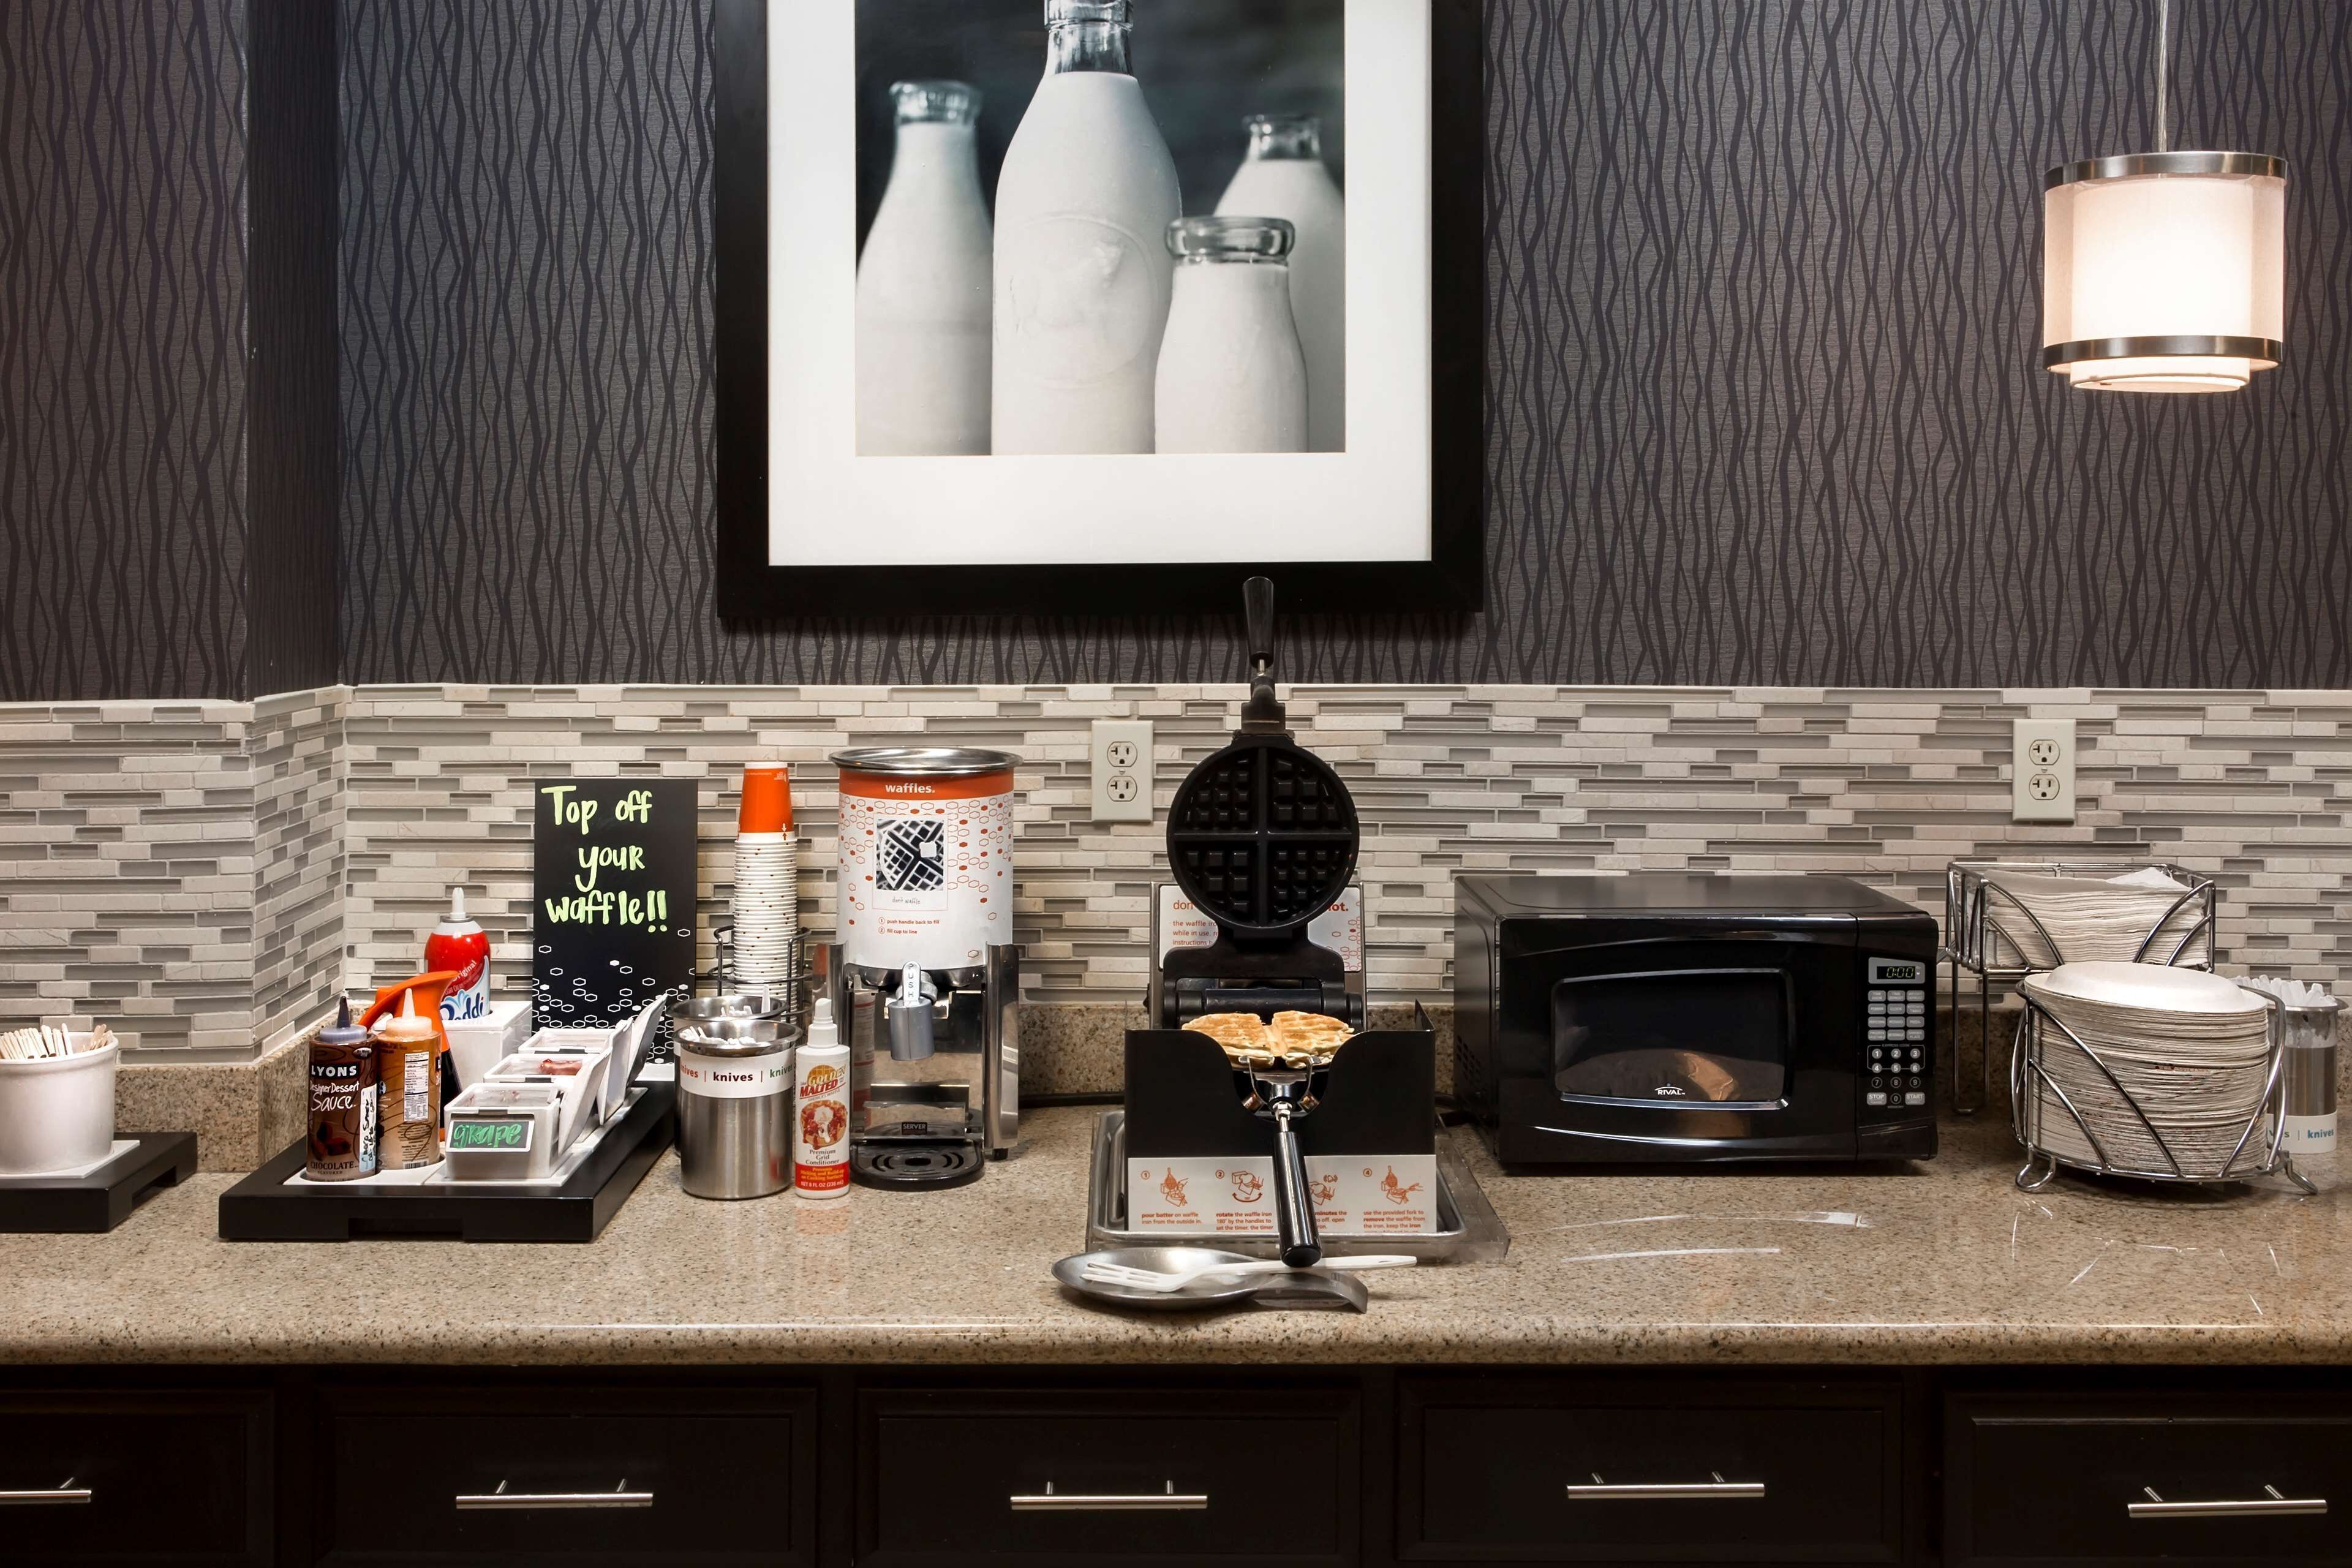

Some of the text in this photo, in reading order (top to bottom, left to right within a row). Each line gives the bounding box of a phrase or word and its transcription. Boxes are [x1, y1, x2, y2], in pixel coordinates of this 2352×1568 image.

[886, 783, 935, 793] waffles.
[541, 785, 652, 835] Top off
[545, 889, 668, 932] waffle!!
[1173, 900, 1349, 911] don ot.
[1887, 967, 1913, 978] 0:00
[311, 1065, 356, 1077] LYONS
[680, 1065, 698, 1078] nives
[713, 1072, 753, 1082] knives
[808, 1064, 846, 1085] GOLDEN
[331, 1080, 359, 1093] Dessert
[800, 1078, 838, 1098] MALTED
[311, 1092, 353, 1111] Sauce
[2308, 1129, 2334, 1138] knives
